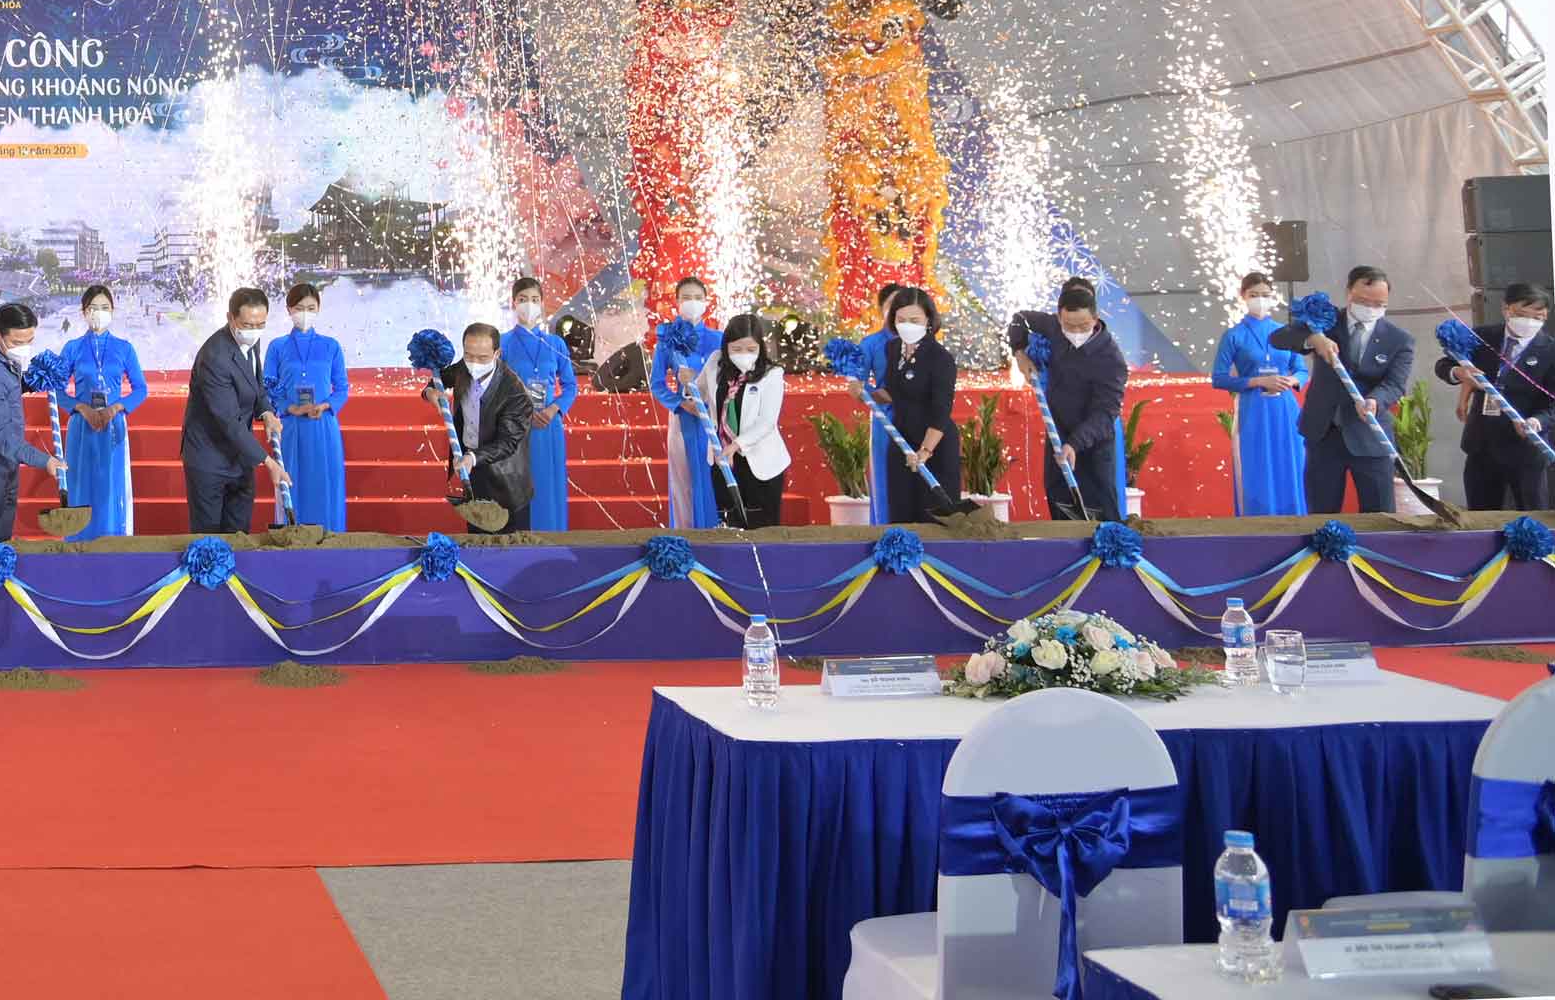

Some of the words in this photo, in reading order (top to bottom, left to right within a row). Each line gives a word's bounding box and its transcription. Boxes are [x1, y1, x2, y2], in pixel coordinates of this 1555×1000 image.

[3, 0, 22, 9] HÓA
[5, 31, 105, 68] CÔNG
[31, 74, 121, 96] KHOÁNG
[127, 75, 189, 96] NÓNG
[28, 106, 102, 124] THANH
[109, 102, 155, 124] HOÁ
[54, 146, 77, 156] 2021
